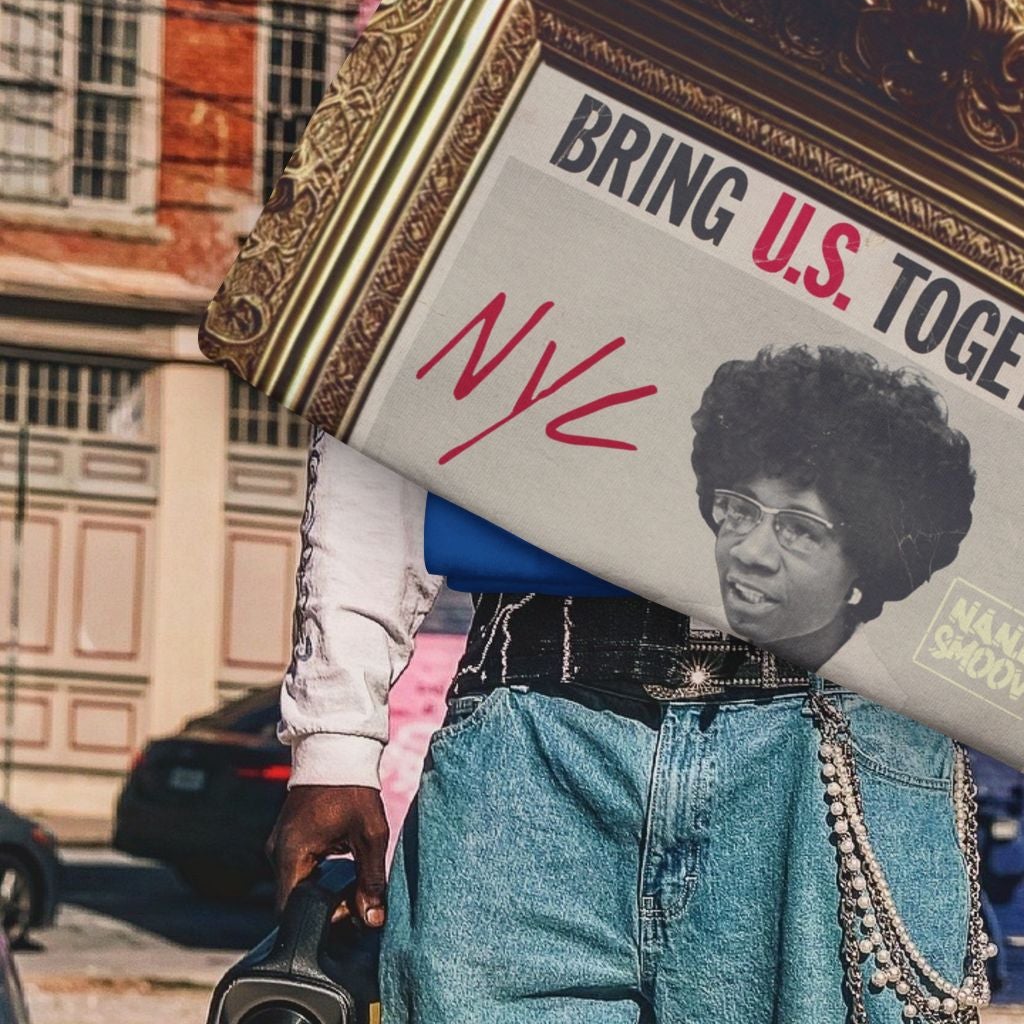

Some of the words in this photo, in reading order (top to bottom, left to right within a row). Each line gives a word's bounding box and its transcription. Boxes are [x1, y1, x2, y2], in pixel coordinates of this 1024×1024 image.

[549, 93, 748, 247] BRING
[751, 191, 862, 311] U.S.
[416, 291, 658, 465] NYC
